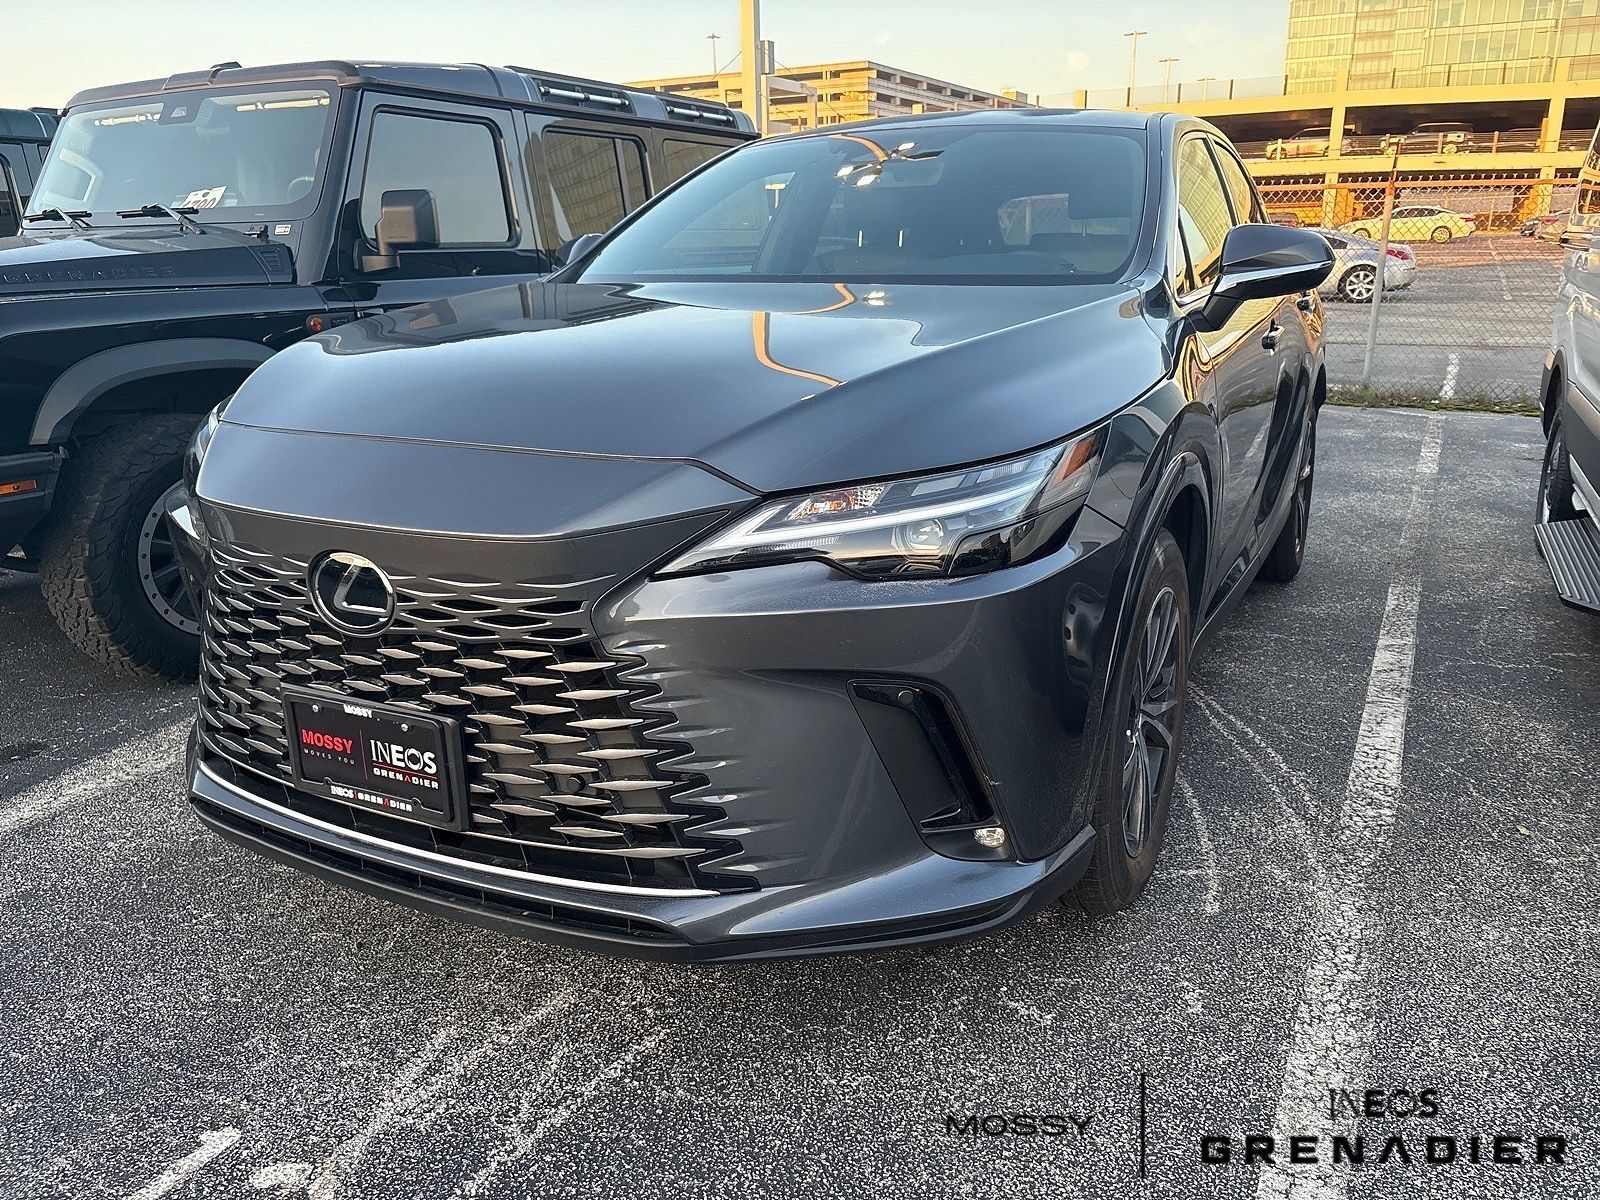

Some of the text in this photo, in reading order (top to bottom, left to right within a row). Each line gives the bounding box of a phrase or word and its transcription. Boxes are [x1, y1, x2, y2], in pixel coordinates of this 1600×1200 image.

[343, 703, 373, 718] MOSSY
[302, 729, 353, 753] MOSSY
[304, 748, 355, 765] MOVES YOU
[369, 739, 437, 775] INEOS
[372, 767, 439, 789] GRENADIER
[330, 785, 413, 812] INEOS GRENADIER
